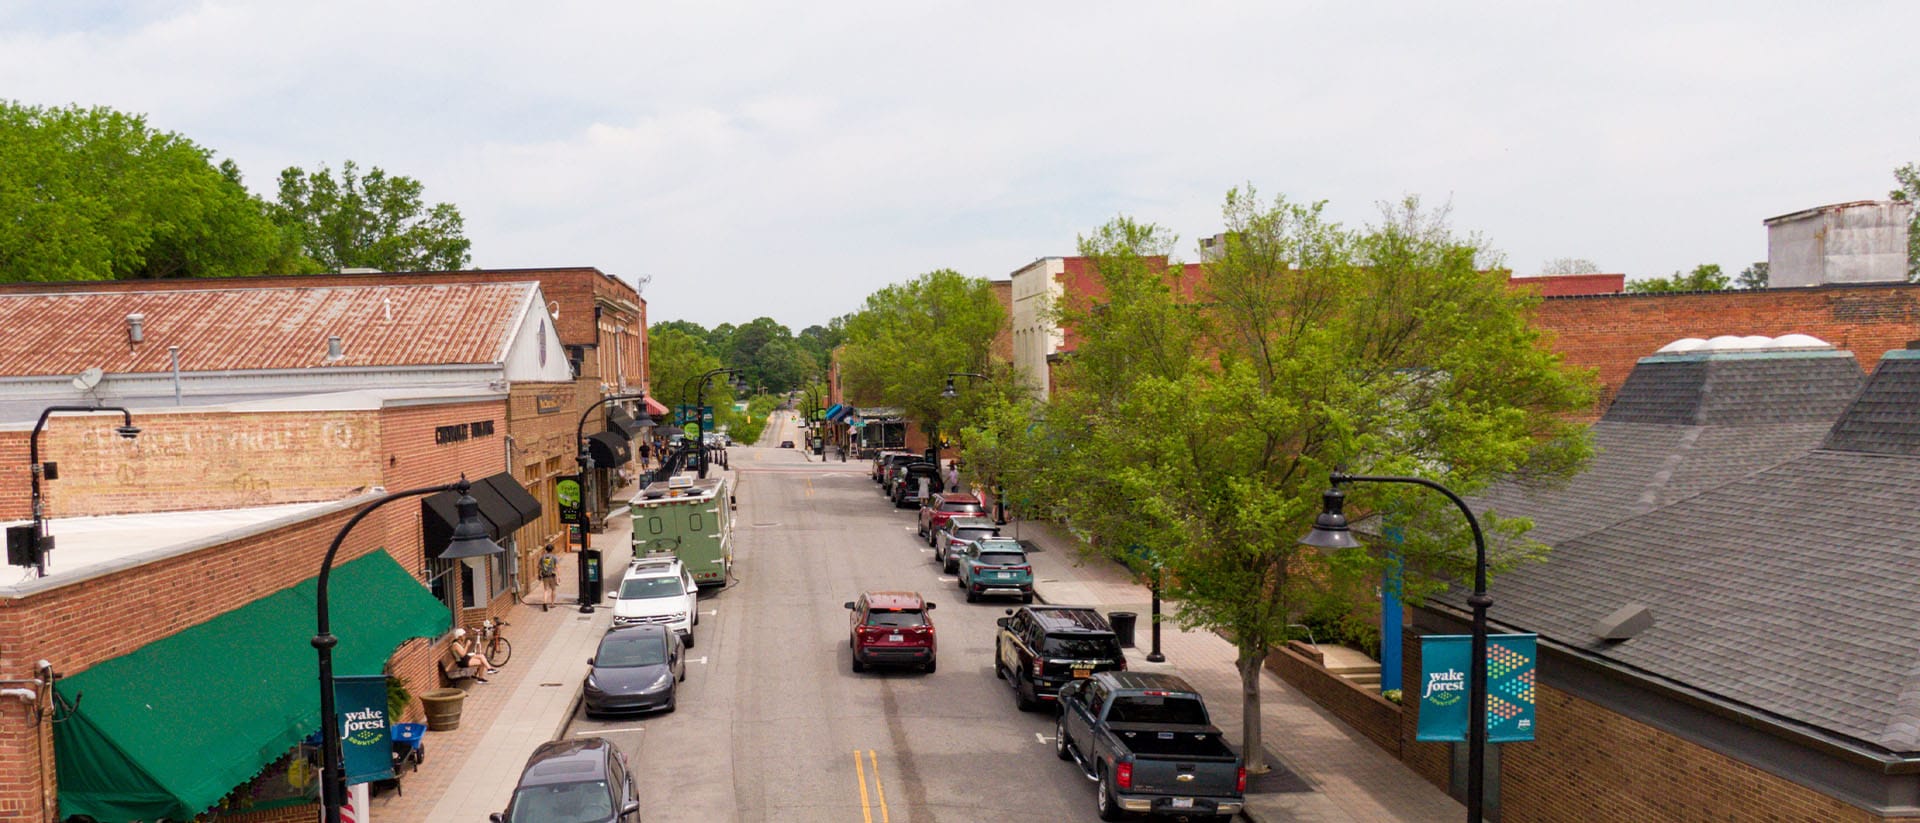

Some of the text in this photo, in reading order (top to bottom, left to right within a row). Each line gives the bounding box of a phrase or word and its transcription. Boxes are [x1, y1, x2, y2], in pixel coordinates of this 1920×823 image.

[1429, 668, 1464, 680] wake
[1423, 680, 1464, 698] forest
[345, 707, 382, 720] wake
[341, 719, 385, 739] forest
[348, 733, 383, 746] DOWNTOWN
